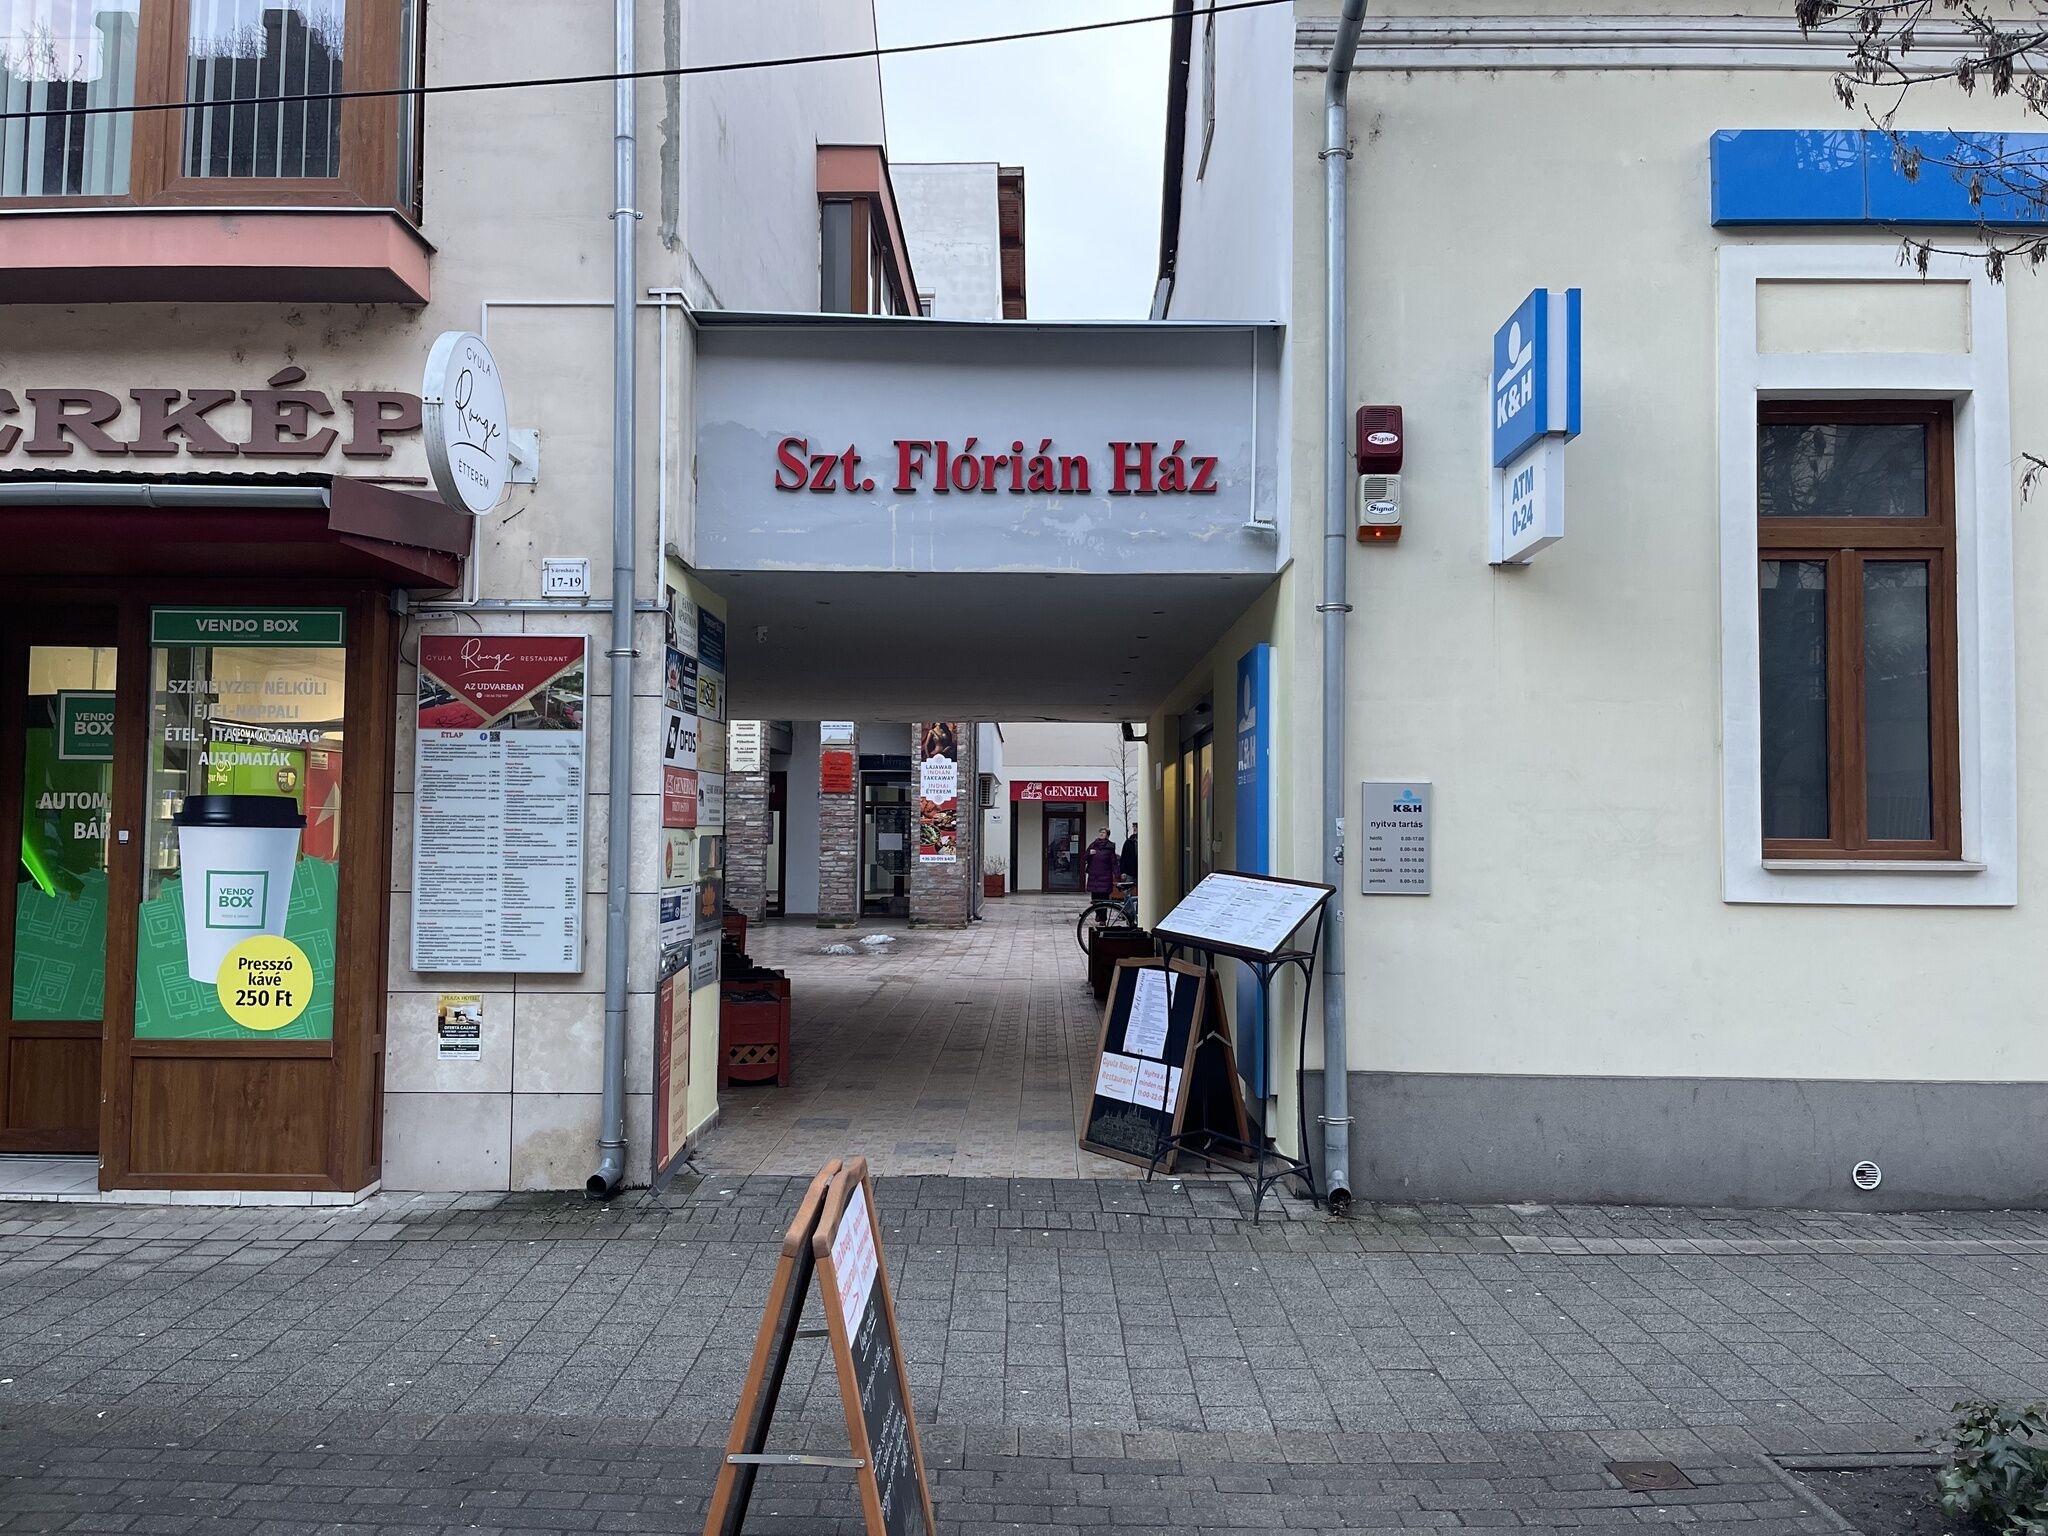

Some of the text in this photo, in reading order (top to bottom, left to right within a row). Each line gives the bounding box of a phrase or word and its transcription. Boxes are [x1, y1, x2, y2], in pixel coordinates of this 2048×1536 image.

[466, 347, 492, 376] GYULA
[1497, 368, 1532, 429] K&H
[455, 366, 501, 453] Rouge
[1370, 434, 1396, 444] Signal
[774, 437, 1219, 495] Szt. Flórián Ház
[458, 459, 490, 491] ÉTTEREM
[1512, 465, 1534, 506] ATM
[1369, 504, 1395, 514] Signal
[1511, 498, 1534, 537] 0-24
[551, 577, 582, 587] 17-19
[196, 619, 299, 633] VENDO BOX
[425, 654, 453, 662] GYULA
[460, 638, 516, 671] Rouge
[168, 677, 327, 696] SZEMÉLYZET NÉLKÜLI
[464, 683, 524, 691] AZ UDVARBAN
[76, 713, 115, 721] VENDO
[194, 700, 299, 721] ÉJJEL-NAPPALI
[74, 722, 114, 735] BOX
[440, 730, 464, 739] ÉTLAP
[680, 730, 696, 753] DFDS
[198, 748, 292, 767] AUTOMATÁK
[1044, 785, 1098, 797] GENERALI
[1393, 804, 1423, 813] K&H
[1370, 821, 1397, 829] nyitva
[219, 888, 255, 896] VENDO
[218, 896, 253, 908] BOX
[238, 956, 293, 971] Presszó
[248, 971, 282, 986] kávé
[236, 990, 292, 1006] 250 Ft
